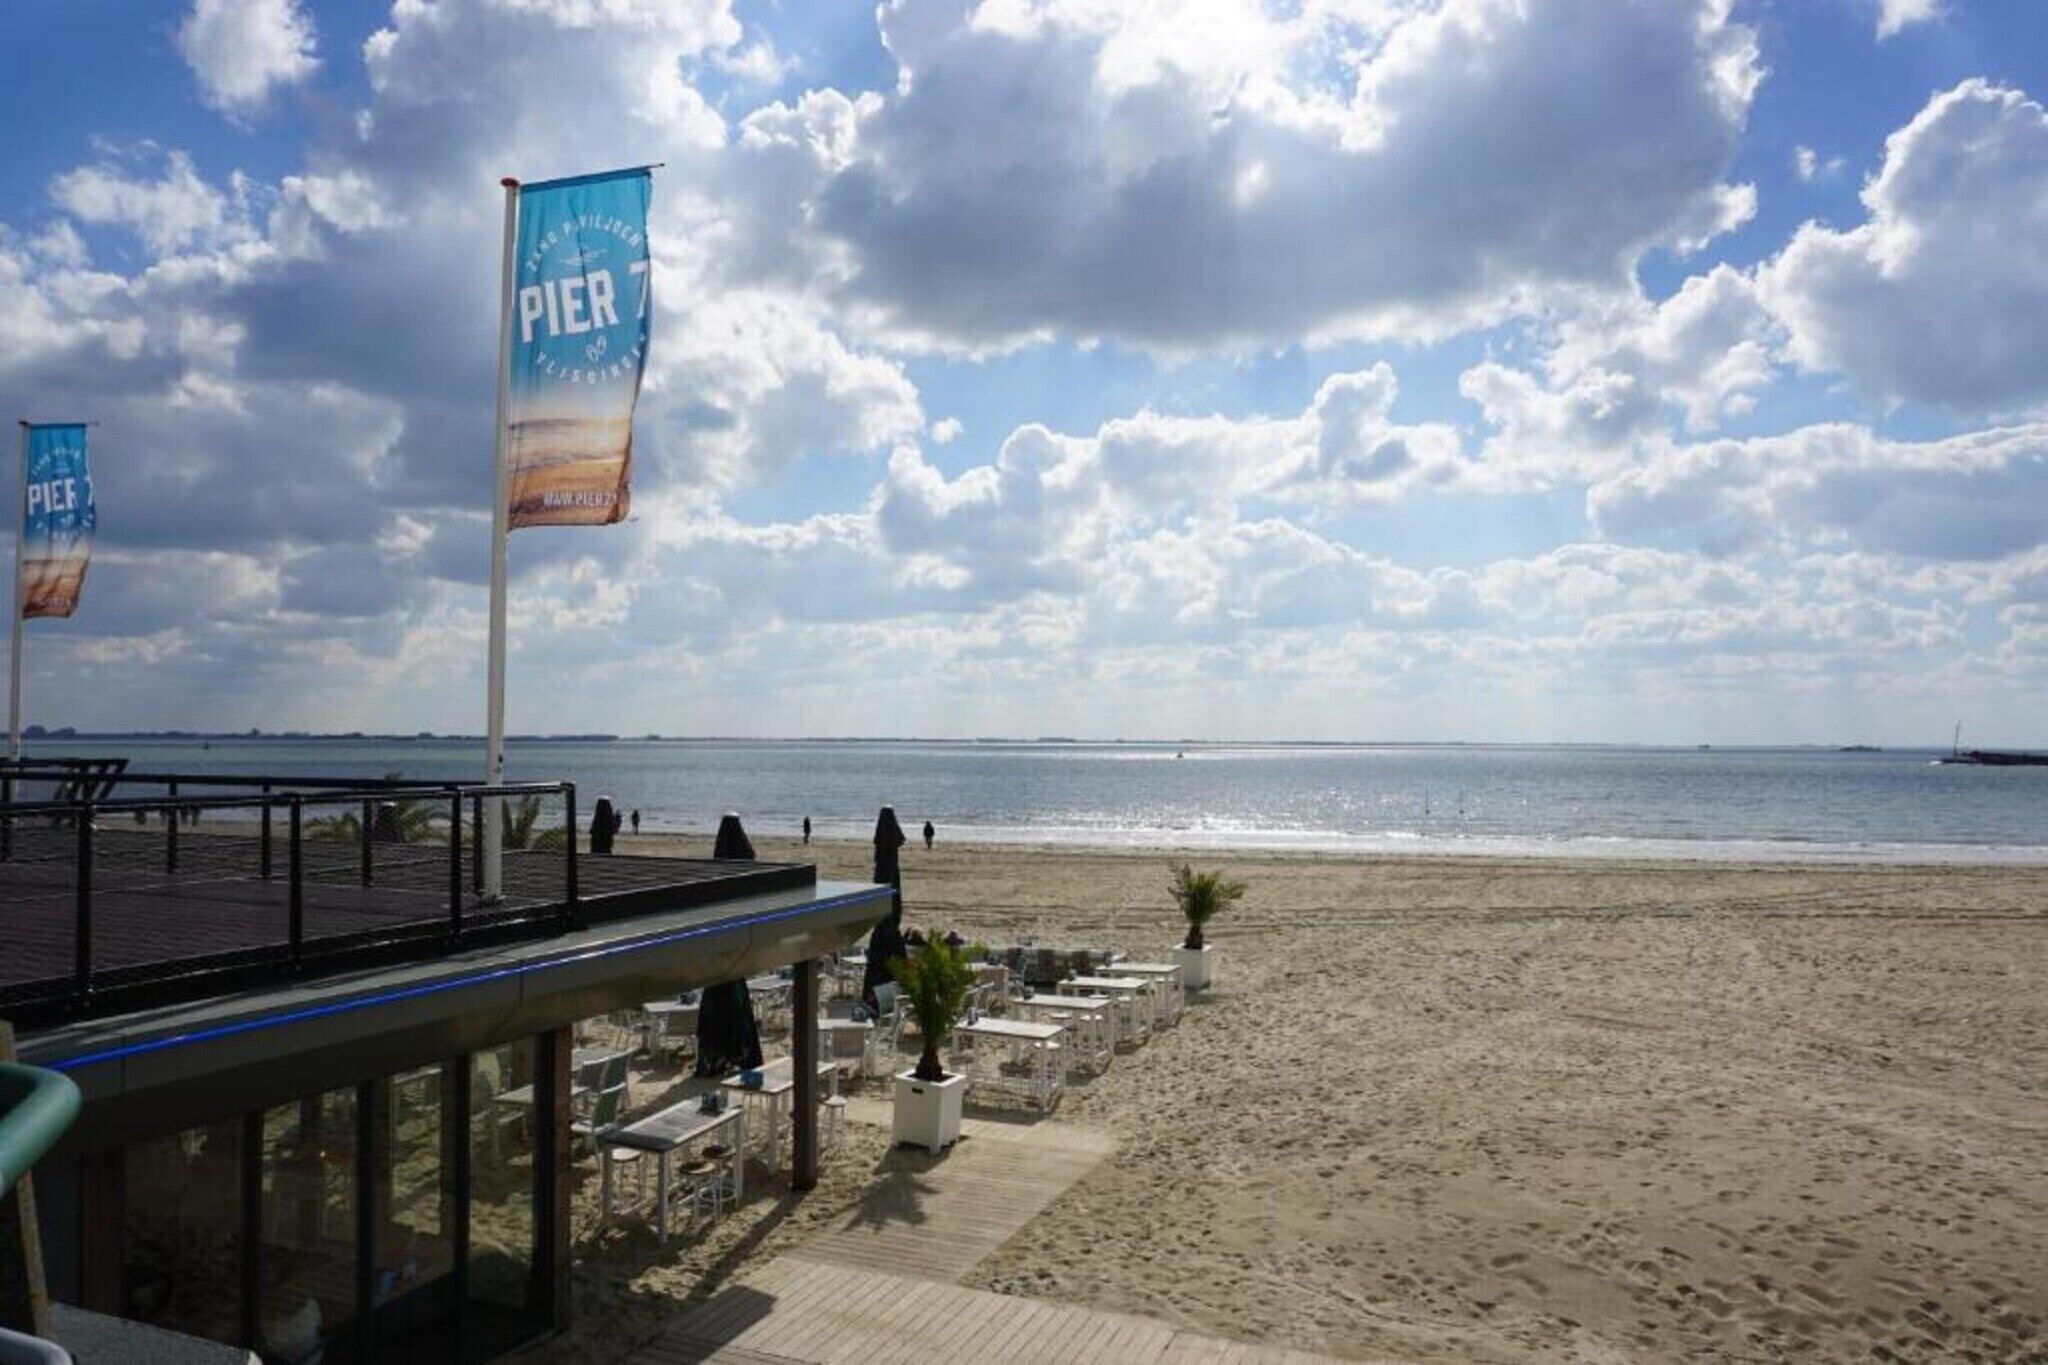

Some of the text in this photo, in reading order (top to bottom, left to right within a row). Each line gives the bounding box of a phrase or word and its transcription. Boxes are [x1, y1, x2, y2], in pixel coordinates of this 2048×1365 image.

[519, 261, 648, 343] PIER 7
[28, 478, 78, 515] PIER
